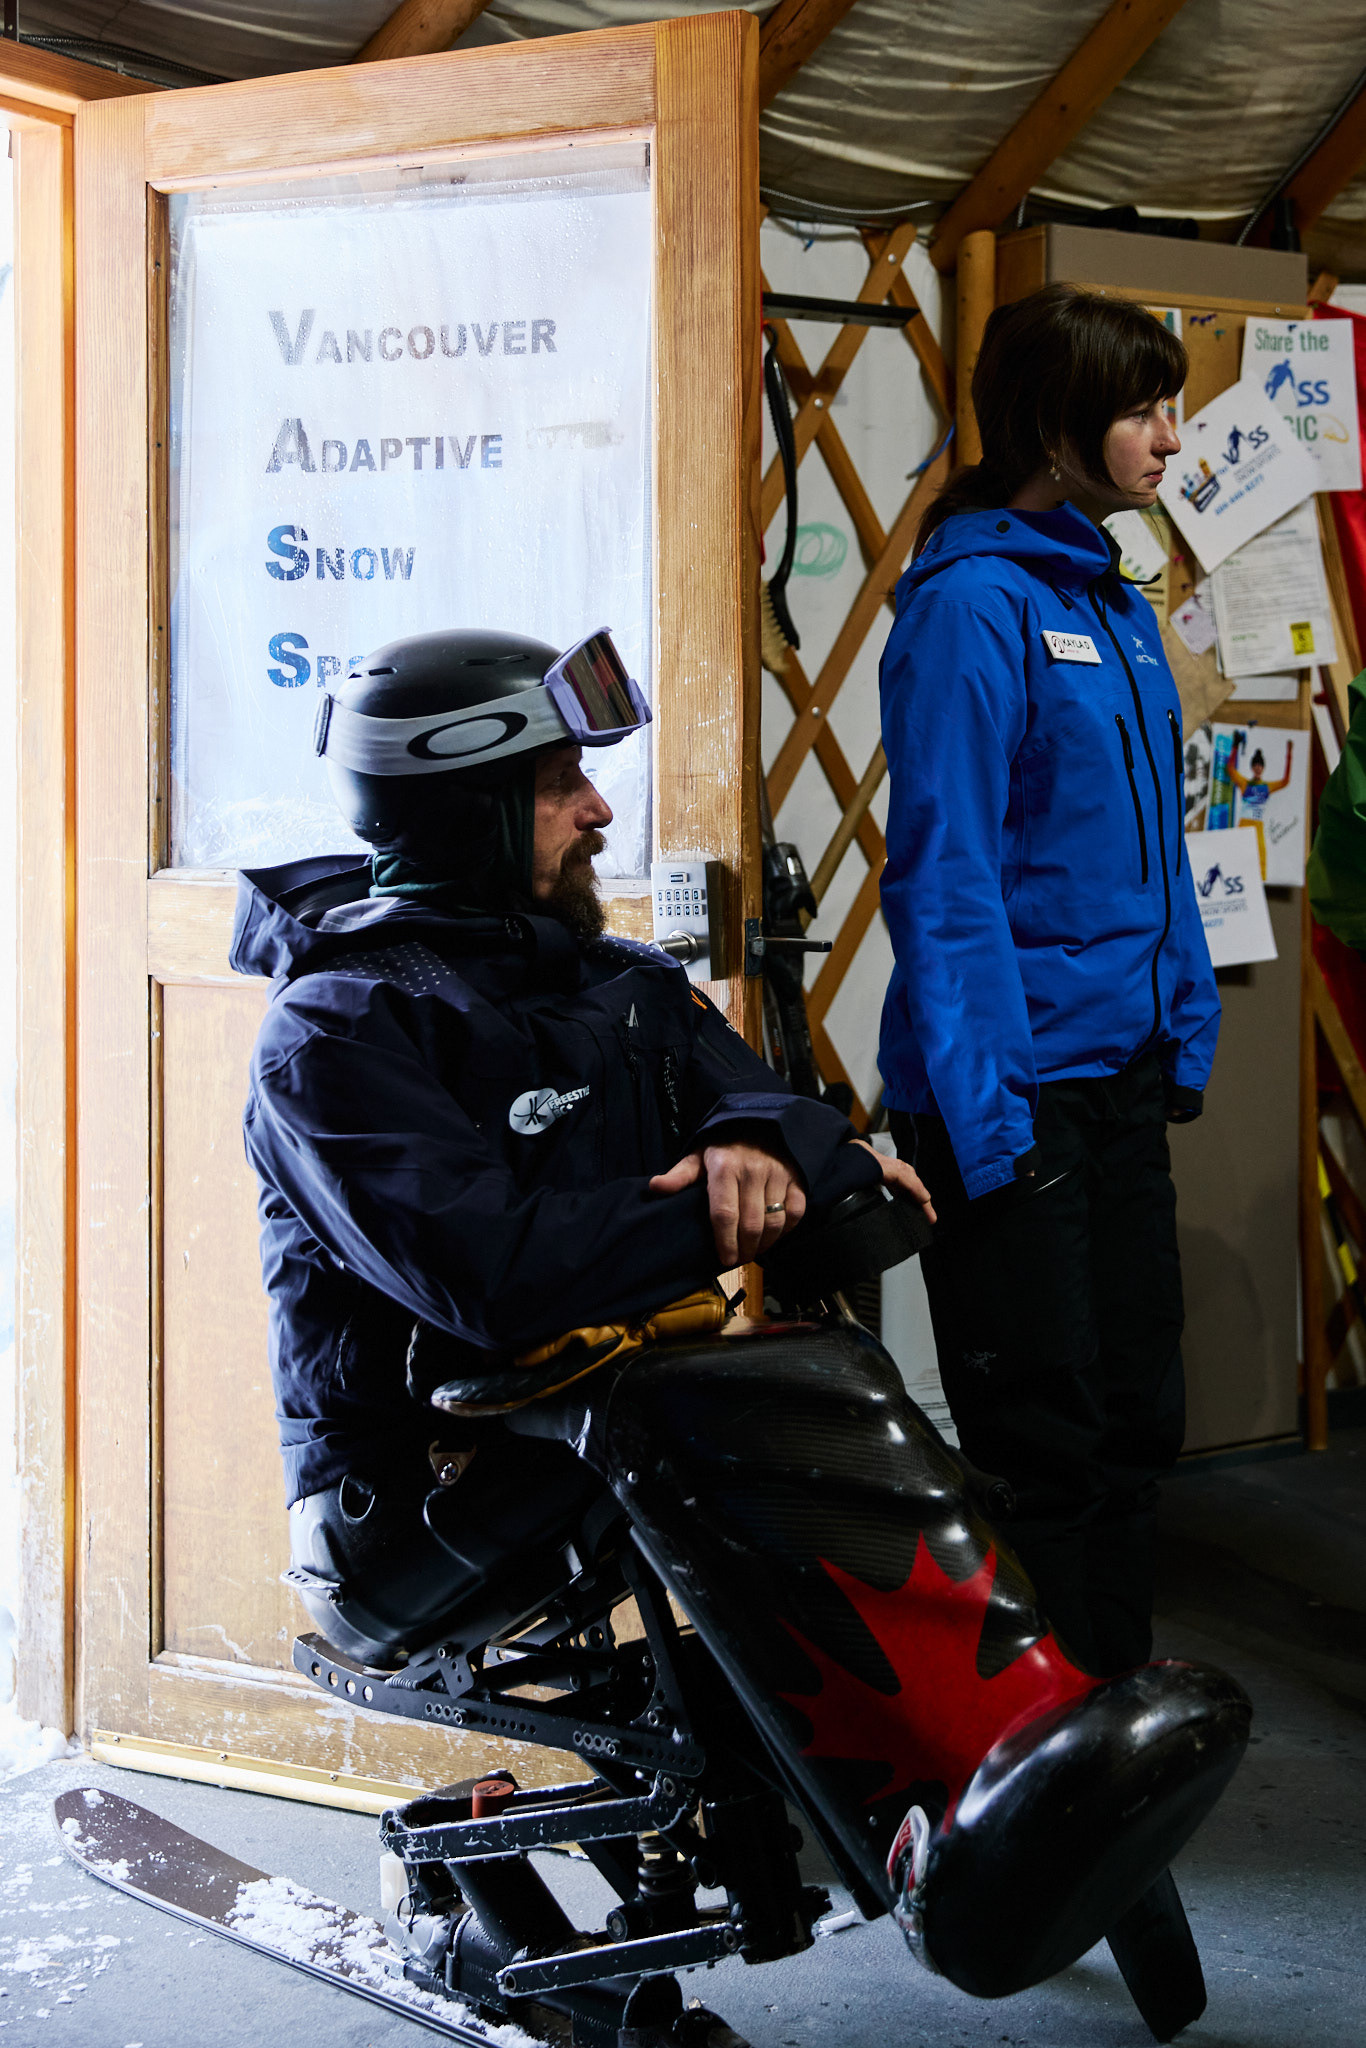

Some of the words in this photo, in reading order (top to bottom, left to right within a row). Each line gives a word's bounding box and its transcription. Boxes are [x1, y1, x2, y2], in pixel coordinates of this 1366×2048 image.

[267, 308, 558, 366] VANCOUVER
[1255, 327, 1294, 353] Share
[1299, 330, 1330, 353] the
[265, 417, 504, 474] ADAPTIVE
[265, 524, 417, 582] SNOW
